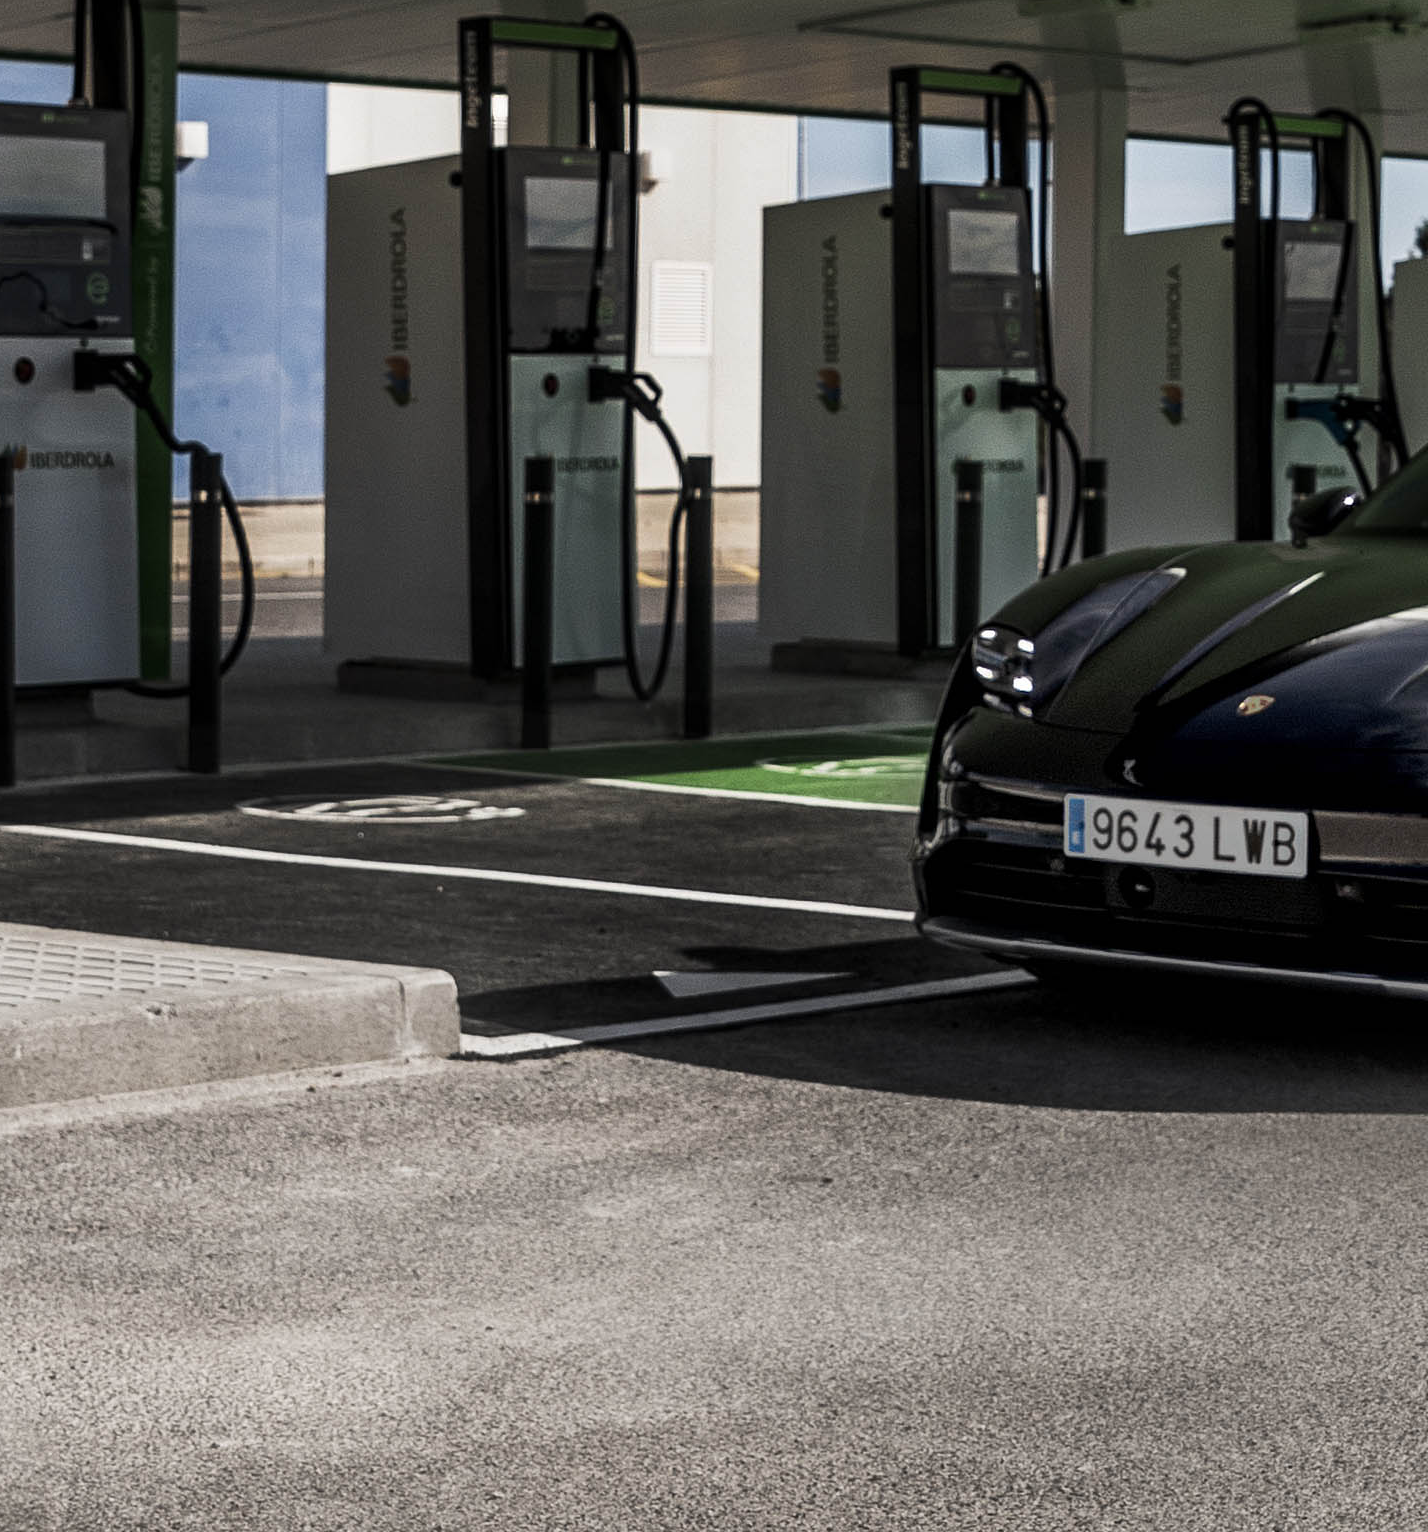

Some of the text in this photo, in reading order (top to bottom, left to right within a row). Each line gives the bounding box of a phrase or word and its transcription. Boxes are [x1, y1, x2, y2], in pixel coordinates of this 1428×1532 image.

[389, 208, 408, 350] IBERDROLA
[29, 450, 115, 469] IBERDROLA
[1092, 806, 1297, 867] 9643 LWB
